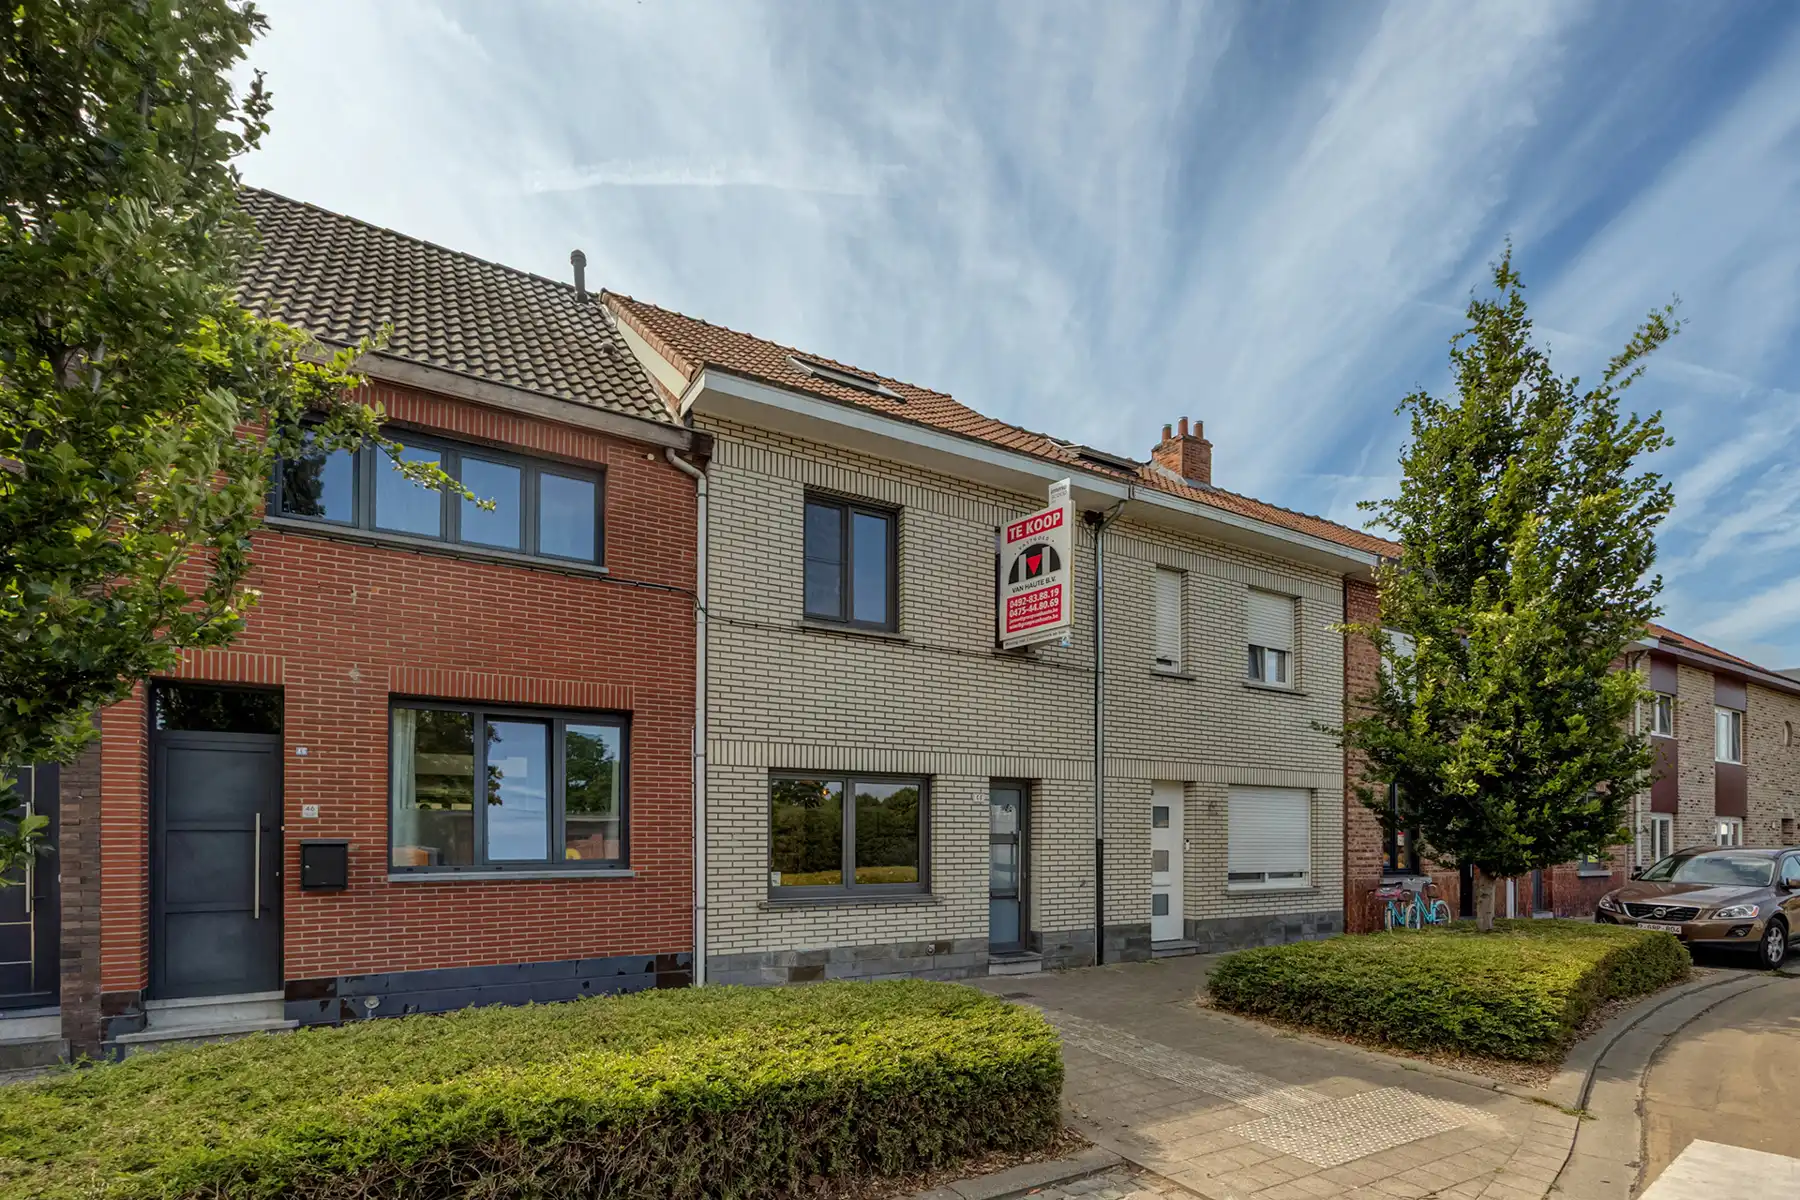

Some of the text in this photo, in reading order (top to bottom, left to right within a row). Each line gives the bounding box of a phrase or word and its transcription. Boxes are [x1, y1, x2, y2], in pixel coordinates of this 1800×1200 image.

[1009, 512, 1061, 541] TE KOOP
[1018, 535, 1049, 550] VASTGOED
[1012, 576, 1056, 593] VAN HAUTE B.V.
[1009, 588, 1059, 609] 0492-83.88.19
[1009, 597, 1059, 618] 0475-44.80.69
